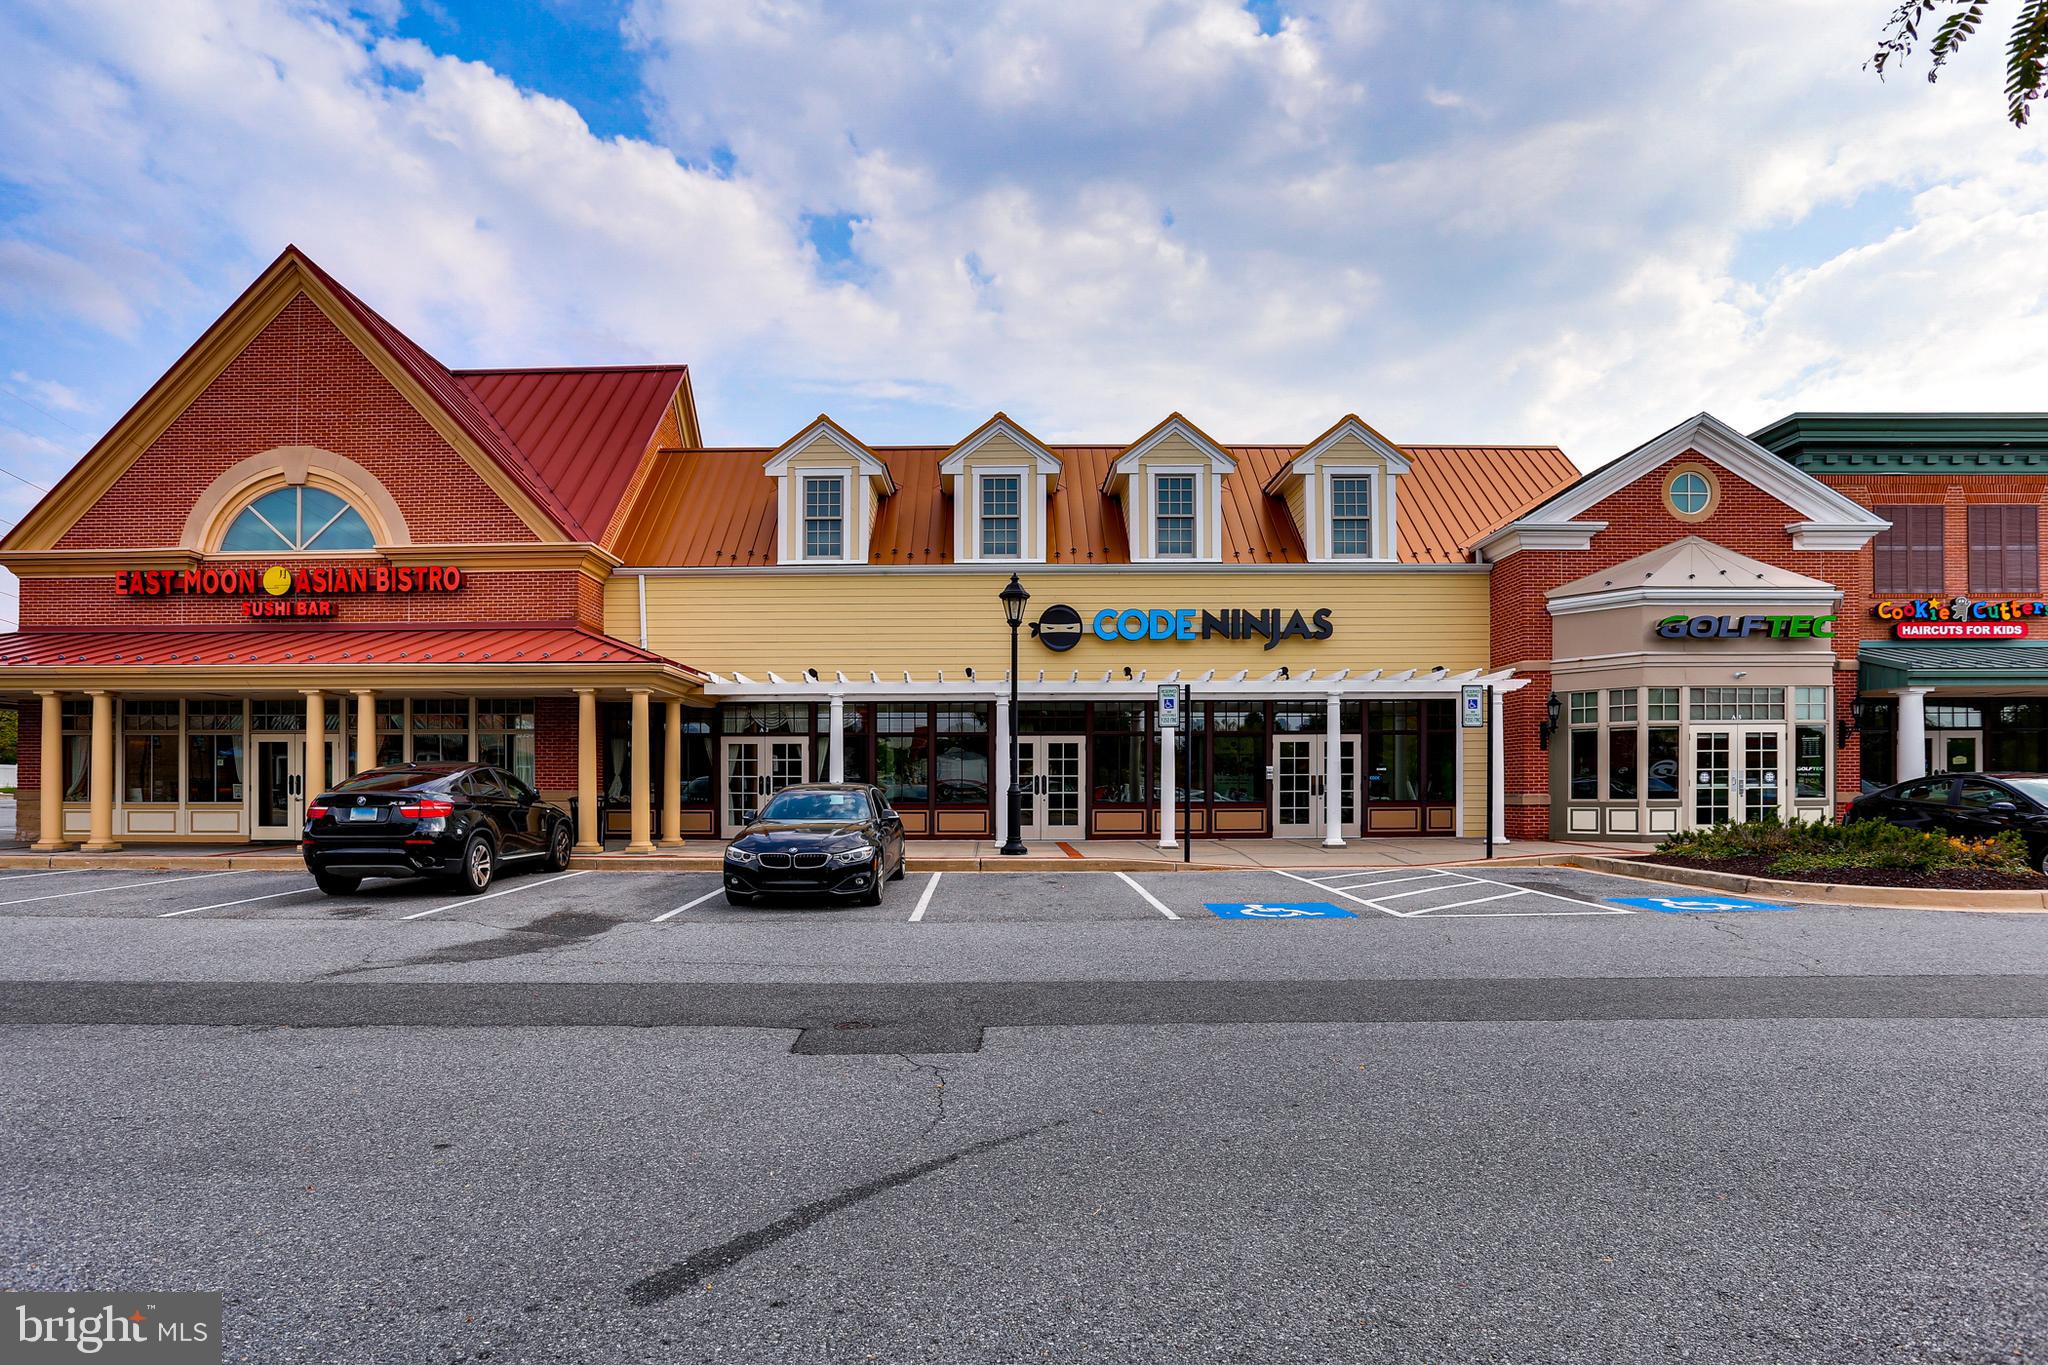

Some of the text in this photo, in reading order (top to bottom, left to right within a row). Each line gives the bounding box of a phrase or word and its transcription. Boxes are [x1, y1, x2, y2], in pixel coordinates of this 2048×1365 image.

[115, 566, 461, 595] EAST MOON ASIAN BISTRO
[241, 601, 331, 616] SUSHI BAR
[1878, 600, 1950, 621] Cookie
[1093, 607, 1334, 652] CODE NINJAS
[1656, 615, 1838, 639] GOLFTEC
[1902, 625, 2023, 635] HAIRCUTS FOR KIDS
